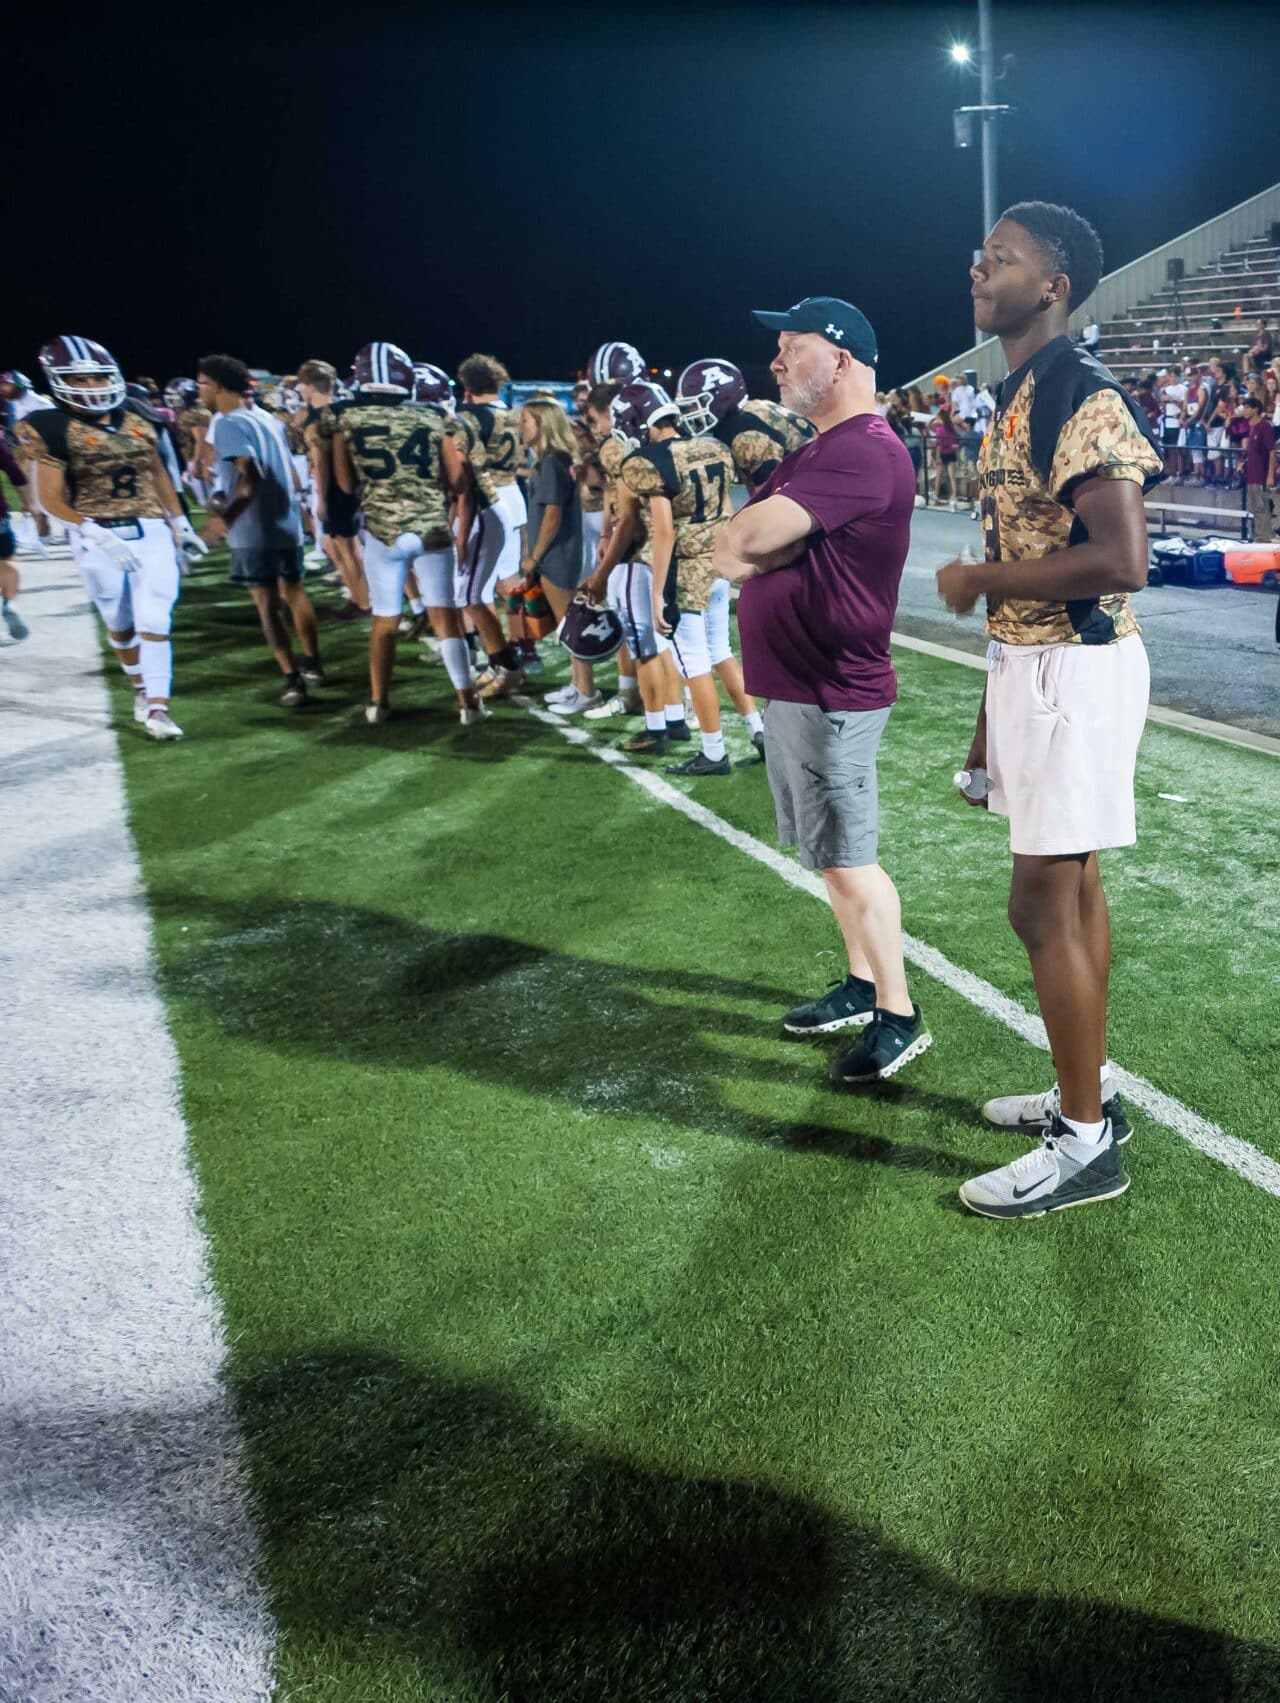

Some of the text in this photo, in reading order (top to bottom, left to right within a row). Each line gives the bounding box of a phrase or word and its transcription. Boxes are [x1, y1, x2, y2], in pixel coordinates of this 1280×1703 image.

[702, 366, 734, 391] A
[354, 425, 434, 479] 54
[689, 461, 725, 524] 17
